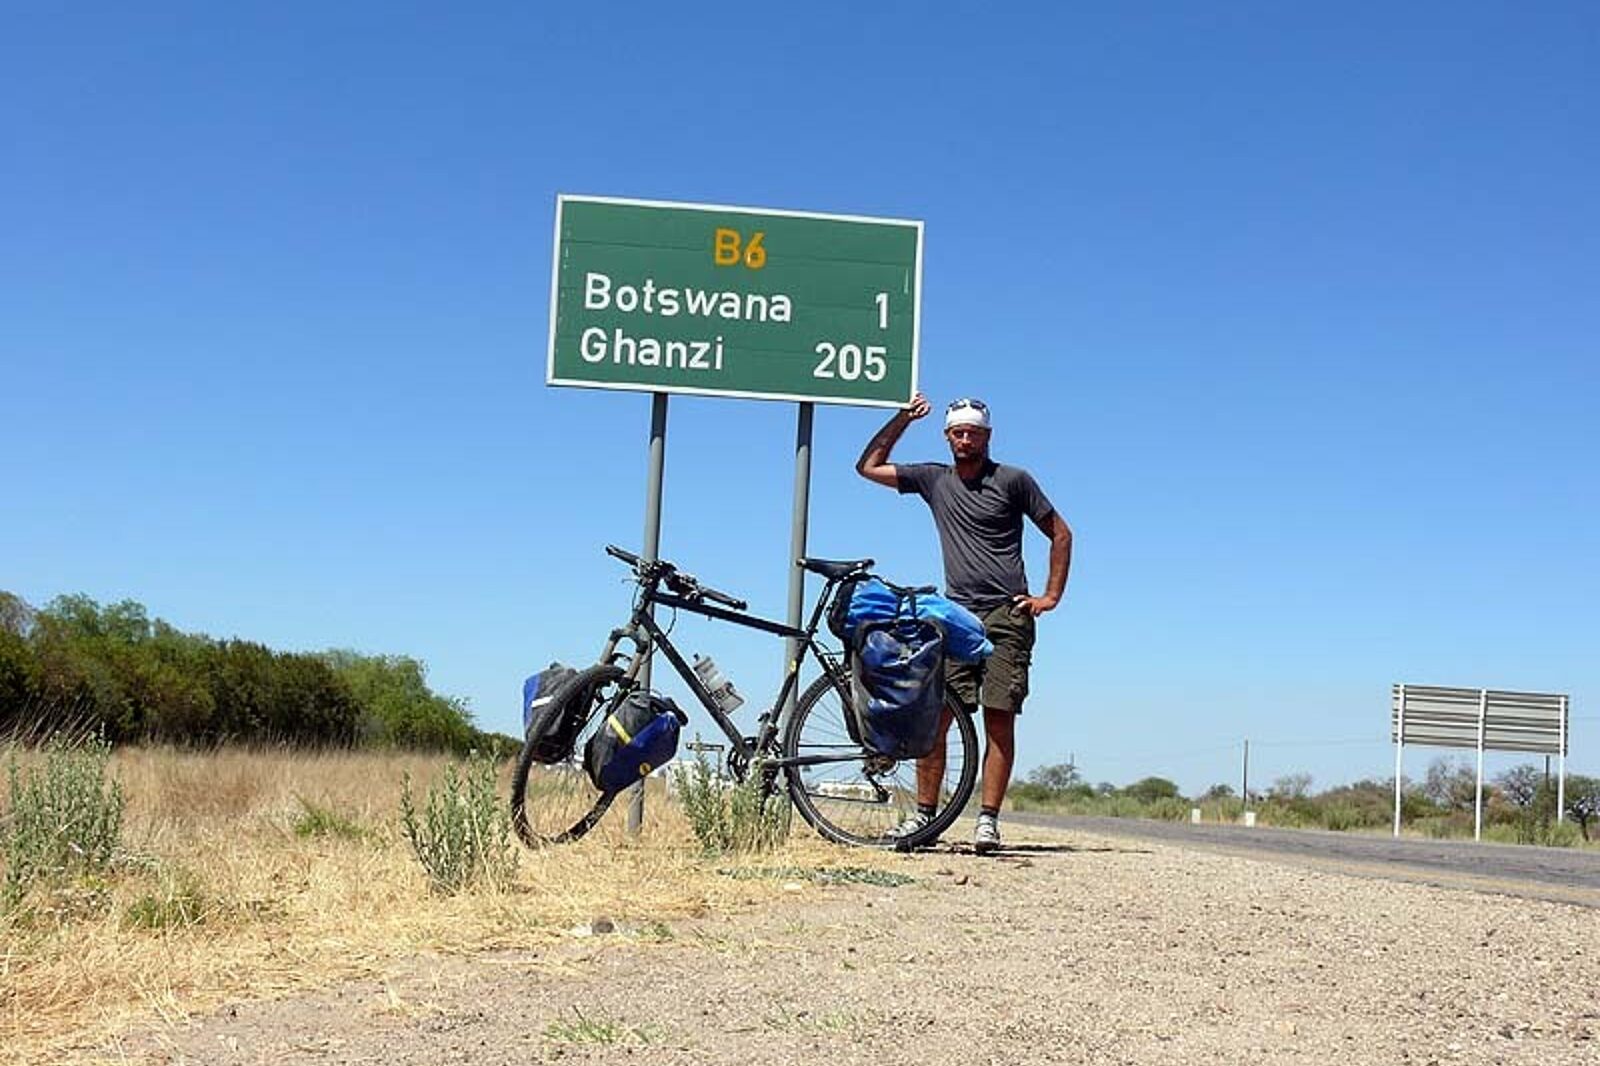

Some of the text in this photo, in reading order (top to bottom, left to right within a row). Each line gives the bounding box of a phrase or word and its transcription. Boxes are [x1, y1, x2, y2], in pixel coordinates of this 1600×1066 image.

[714, 228, 766, 269] B6
[584, 272, 889, 329] Botswana 1
[579, 326, 887, 382] Ghanzi 205
